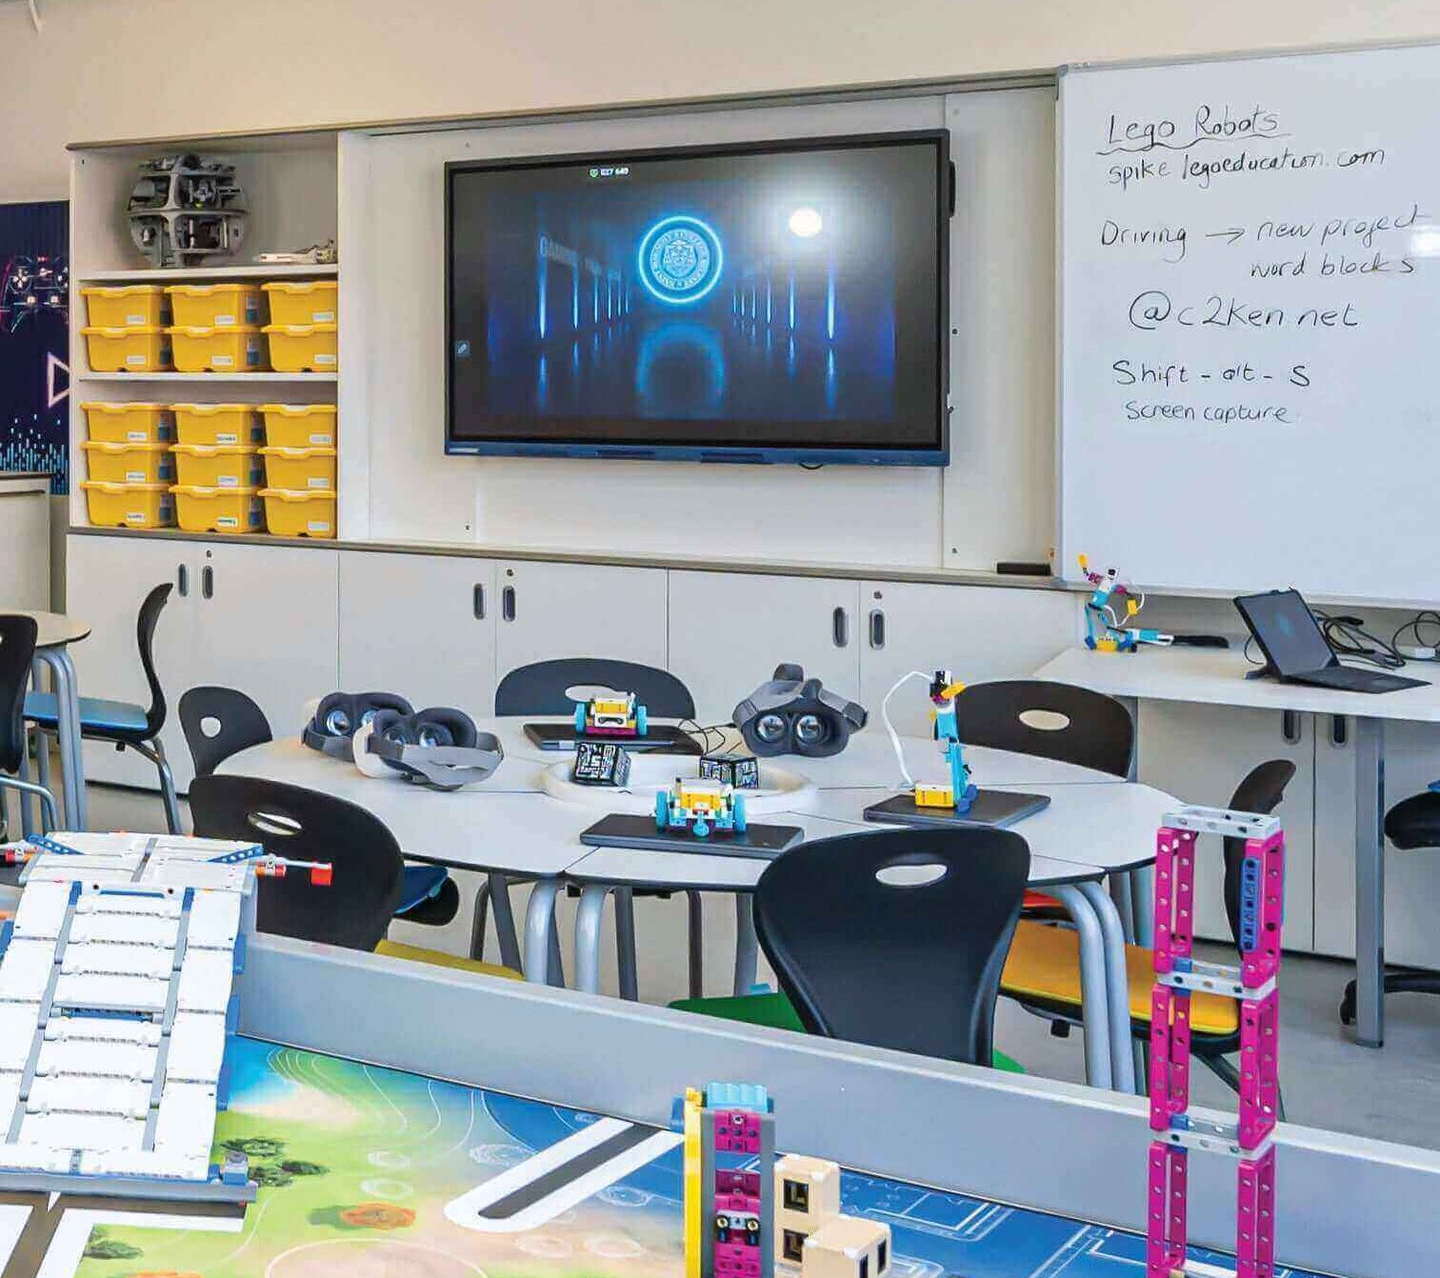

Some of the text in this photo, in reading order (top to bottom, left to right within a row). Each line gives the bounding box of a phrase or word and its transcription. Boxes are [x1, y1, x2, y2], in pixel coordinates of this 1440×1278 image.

[1109, 105, 1280, 150] Lego Robots
[1101, 205, 1432, 263] Driving new project
[1251, 252, 1305, 277] word
[1112, 360, 1189, 387] Shift
[1203, 404, 1293, 424] capture
